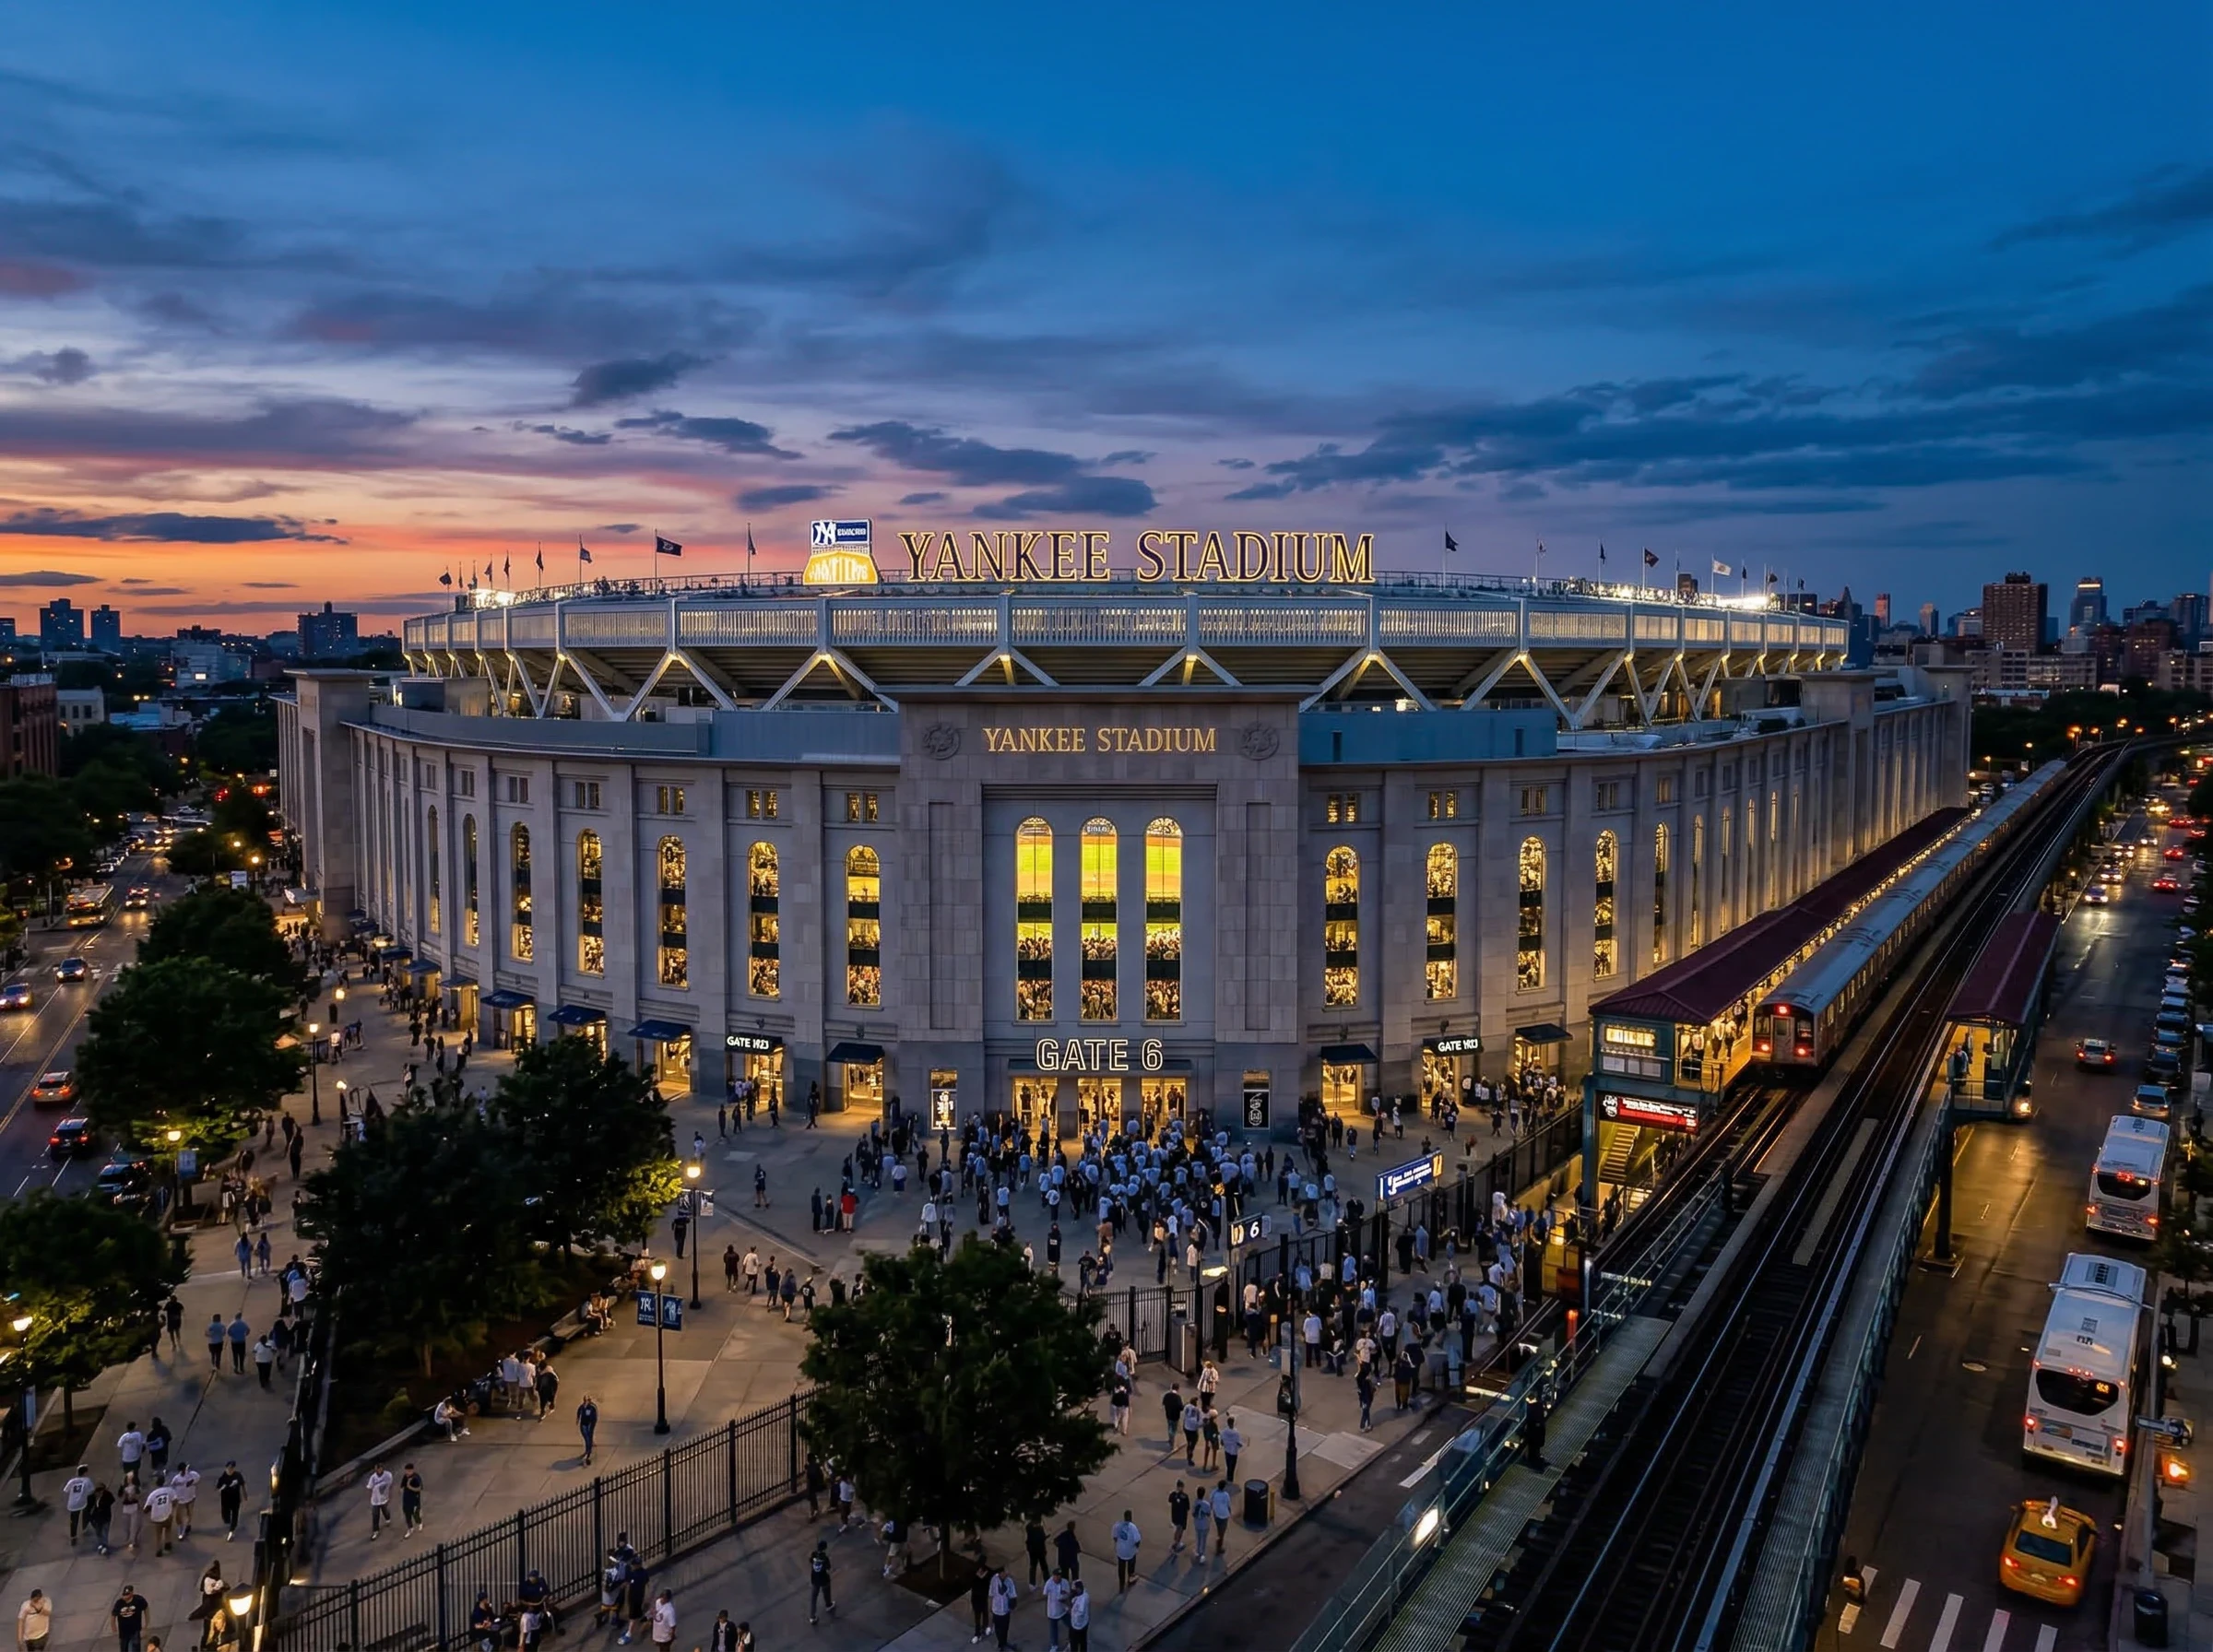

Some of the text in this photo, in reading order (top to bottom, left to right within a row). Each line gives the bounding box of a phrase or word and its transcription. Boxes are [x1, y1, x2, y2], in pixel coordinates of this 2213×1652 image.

[896, 530, 1111, 584] YANKEE
[1136, 529, 1377, 584] STADIUM
[983, 727, 1216, 752] YANKEE STADIUM
[727, 1035, 751, 1048] GATE
[1438, 1040, 1462, 1052] GATE
[1035, 1038, 1164, 1071] GATE 6
[1249, 1221, 1260, 1238] 6
